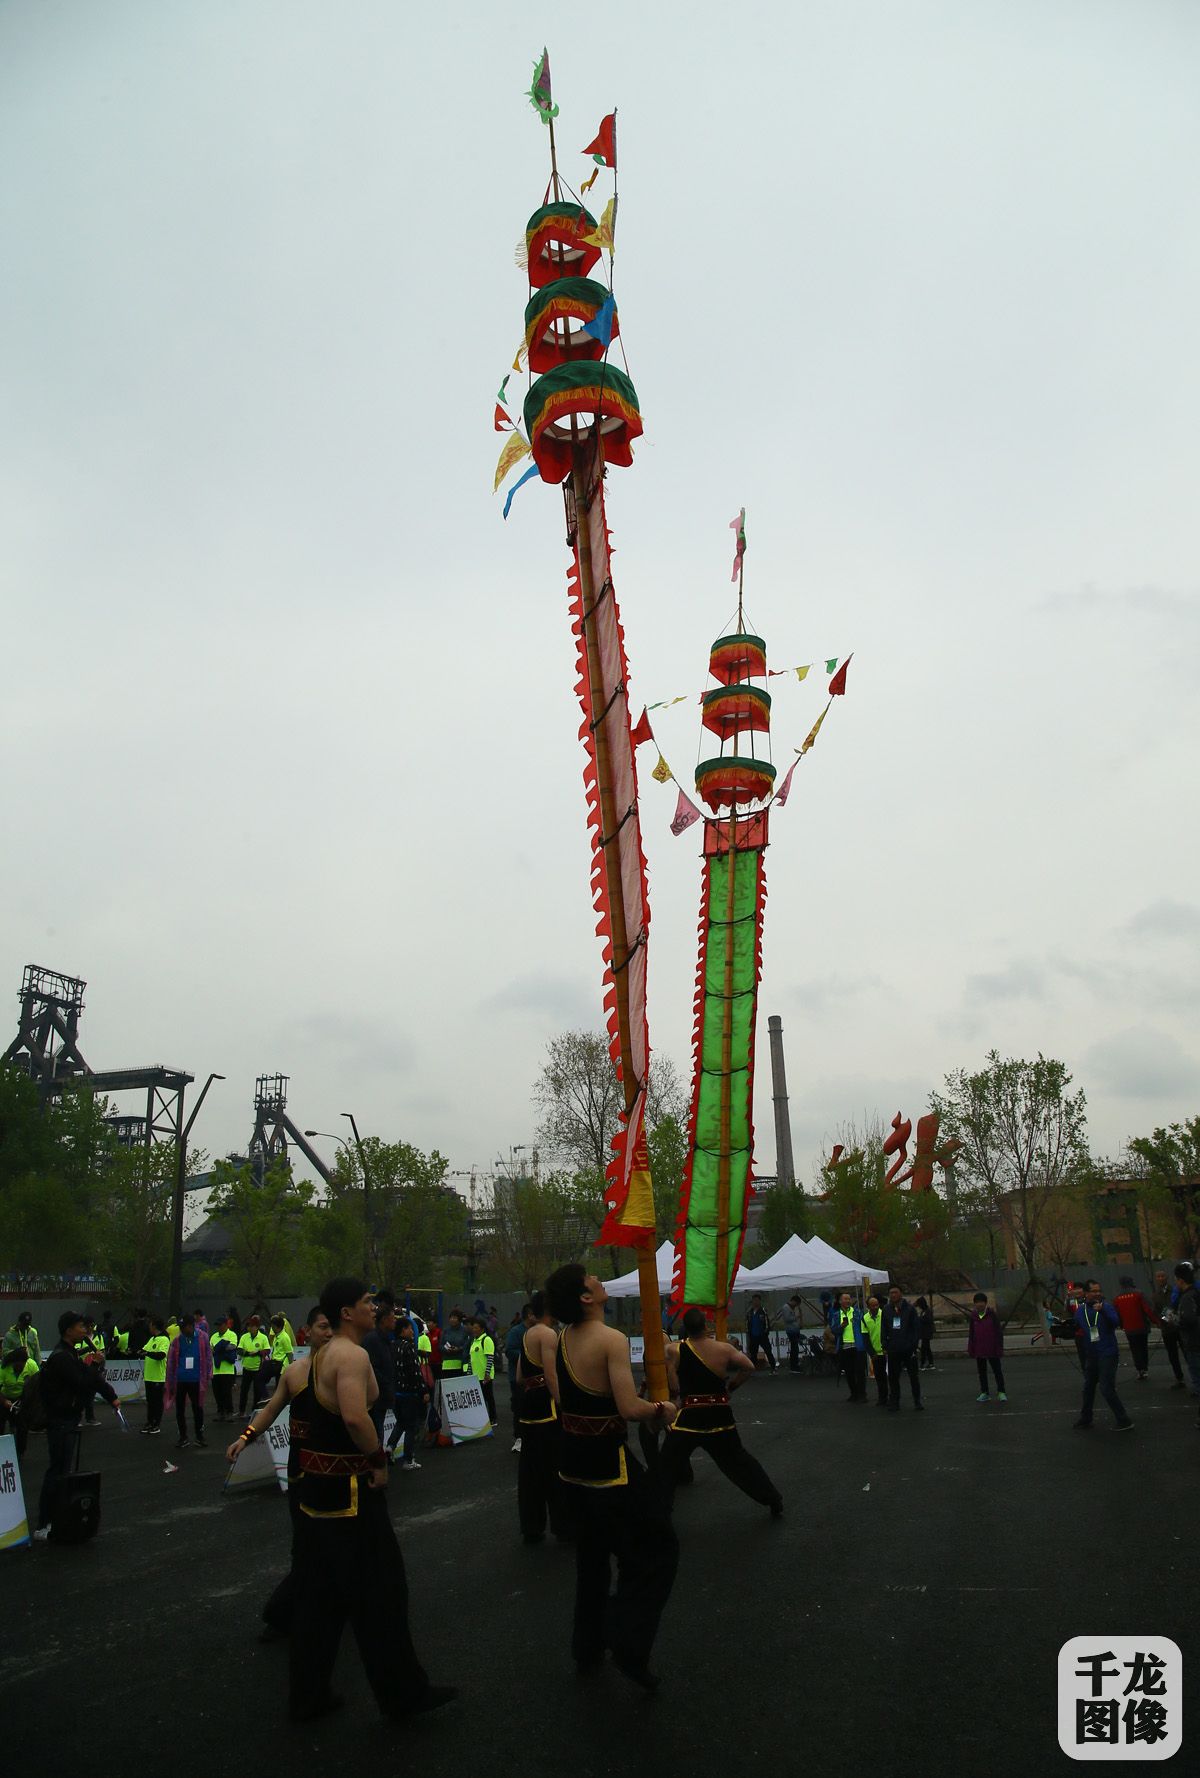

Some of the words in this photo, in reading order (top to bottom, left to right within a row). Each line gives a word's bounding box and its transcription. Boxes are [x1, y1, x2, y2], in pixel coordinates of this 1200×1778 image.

[103, 1369, 141, 1382] 山区人民政府
[445, 1388, 482, 1412] 石景山区体育局
[0, 1460, 16, 1494] 府
